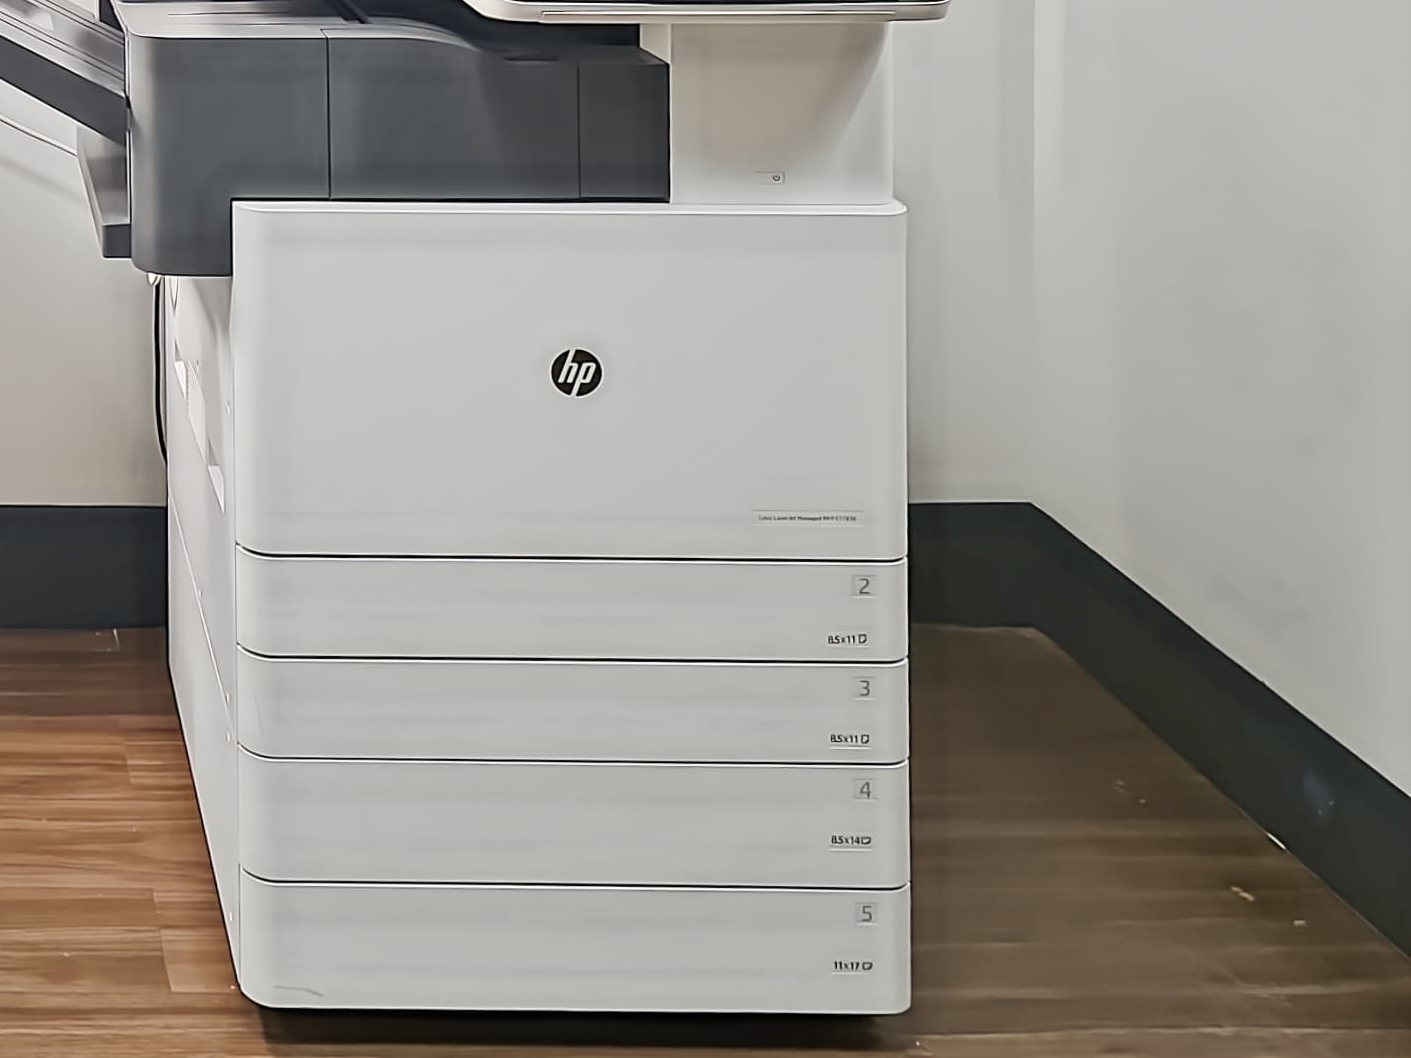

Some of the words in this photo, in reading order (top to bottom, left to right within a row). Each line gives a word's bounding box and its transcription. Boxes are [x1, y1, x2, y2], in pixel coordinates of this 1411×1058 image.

[554, 348, 599, 398] hp
[859, 578, 870, 595] 2
[859, 680, 871, 697] 3
[859, 781, 872, 799] 4
[860, 905, 873, 923] 5
[834, 961, 860, 971] 11x17
